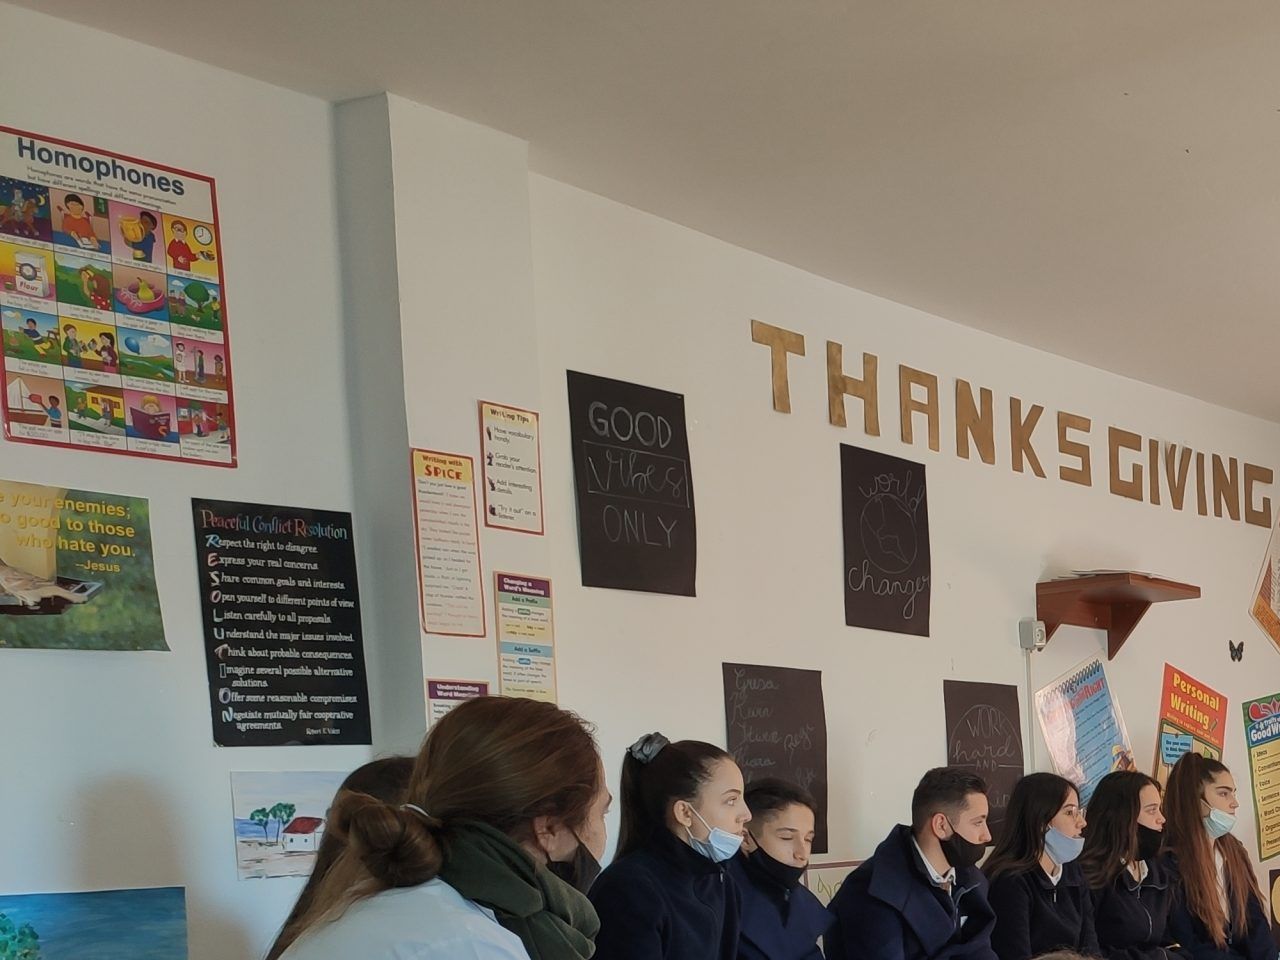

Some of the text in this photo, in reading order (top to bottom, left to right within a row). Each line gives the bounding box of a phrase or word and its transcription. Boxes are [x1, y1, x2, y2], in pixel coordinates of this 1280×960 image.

[18, 137, 185, 195] Homophones
[20, 282, 39, 292] Flour
[588, 402, 671, 448] GOOD
[422, 456, 446, 464] Writing
[425, 465, 462, 480] SPICE
[12, 493, 48, 508] your
[56, 499, 130, 519] enemies;
[18, 514, 135, 537] good to those
[201, 510, 347, 539] Peaceful Conflict Resolution
[603, 505, 676, 548] ONLY
[16, 534, 136, 557] who hate you.
[206, 534, 242, 548] Respect
[243, 539, 255, 548] the
[257, 540, 275, 552] right
[208, 552, 245, 567] Express
[246, 559, 265, 568] your
[268, 558, 282, 567] real
[242, 577, 275, 586] common
[276, 577, 295, 587] goals
[298, 578, 312, 587] and
[237, 593, 267, 604] yourself
[276, 595, 306, 605] different
[308, 596, 329, 607] points
[331, 597, 337, 607] of
[244, 611, 276, 623] carefully
[287, 612, 296, 622] all
[266, 630, 278, 638] the
[280, 632, 300, 641] major
[302, 632, 324, 640] issues
[248, 647, 268, 657] about
[270, 648, 300, 659] probable
[256, 664, 282, 674] several
[284, 666, 312, 677] possible
[314, 666, 353, 676] alternative
[246, 694, 265, 702] some
[267, 692, 308, 703] reasonable
[1173, 672, 1219, 711] Personal
[264, 710, 297, 721] mutually
[299, 710, 312, 719] fair
[314, 711, 353, 721] cooperative
[1171, 693, 1209, 730] Writing
[1251, 727, 1271, 742] Good
